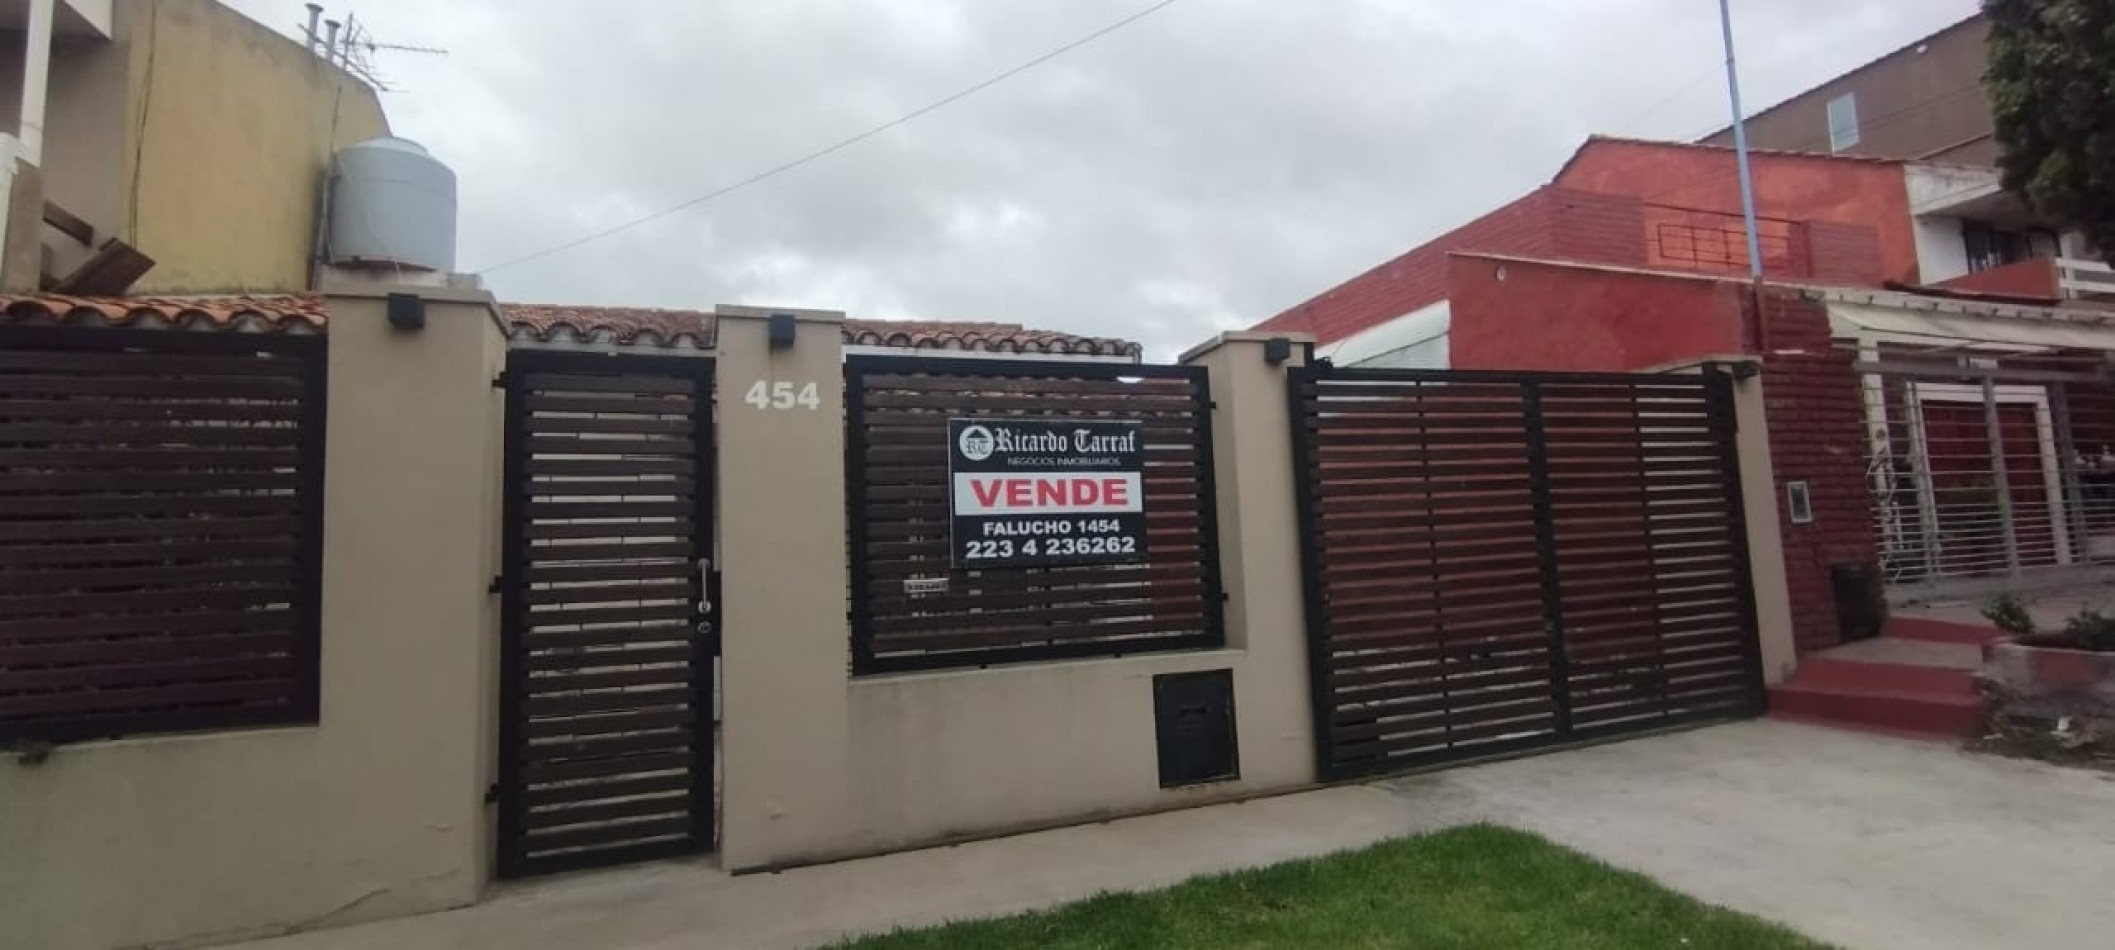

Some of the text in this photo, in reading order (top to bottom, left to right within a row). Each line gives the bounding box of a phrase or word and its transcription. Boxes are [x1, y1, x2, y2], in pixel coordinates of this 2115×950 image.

[745, 380, 820, 410] 454
[995, 427, 1136, 452] Ricardo Tarraf
[1007, 457, 1055, 467] NEGOCIOS
[970, 478, 1130, 508] VENDE
[983, 518, 1121, 536] FALUCHO 1454
[965, 536, 1136, 559] 223 4 236262
